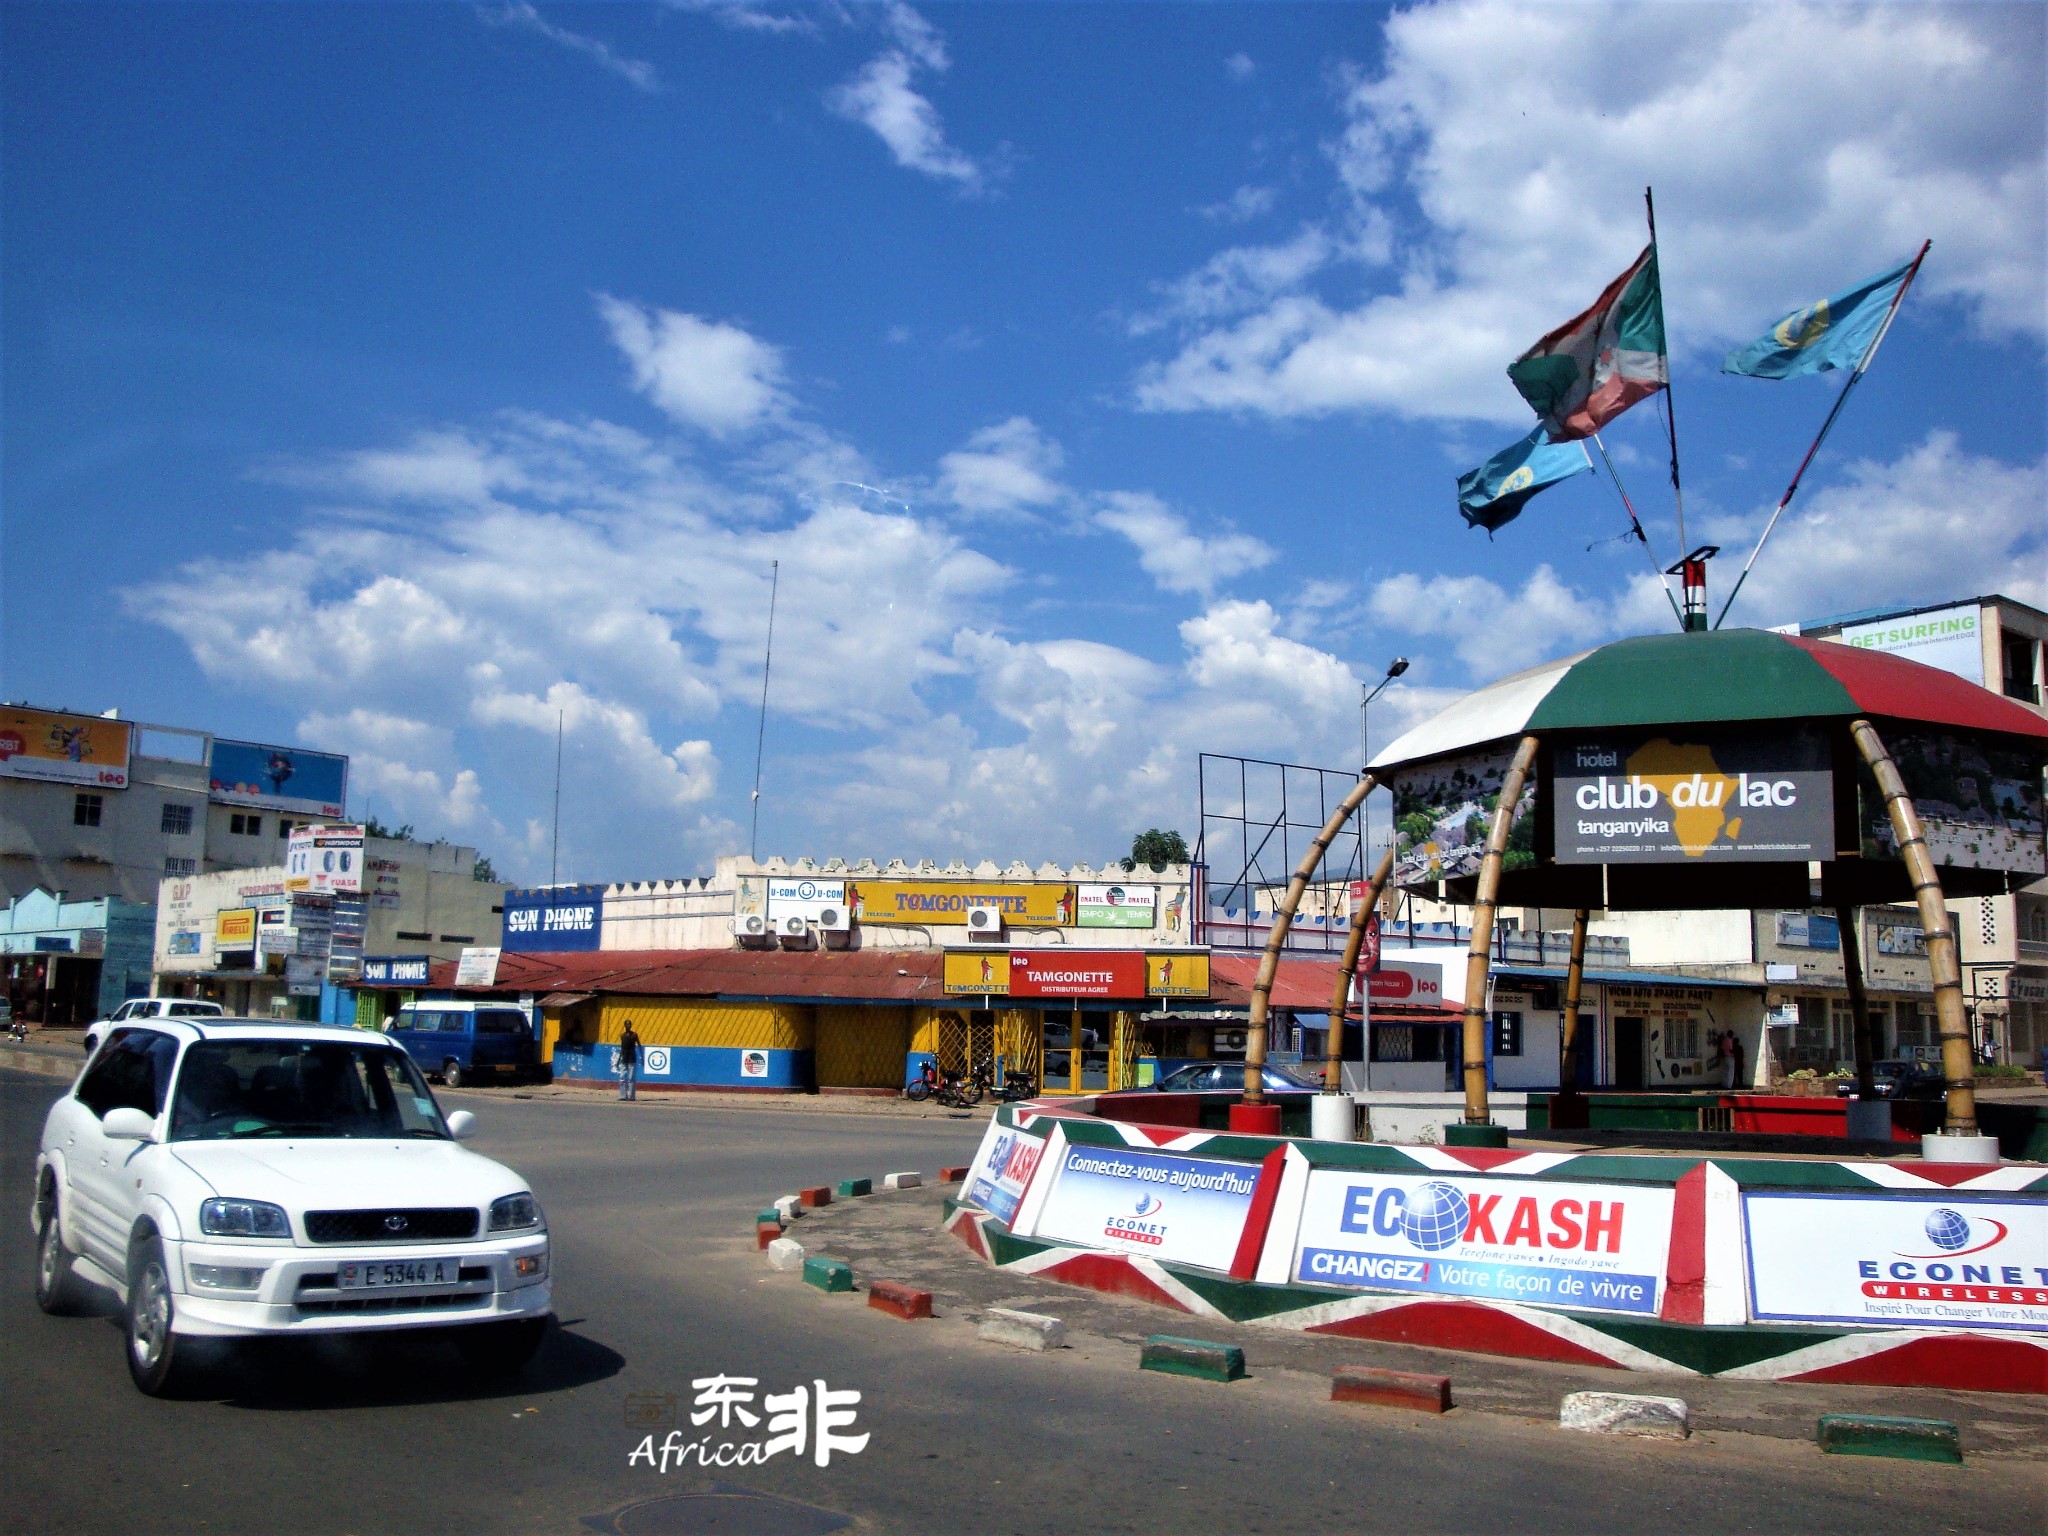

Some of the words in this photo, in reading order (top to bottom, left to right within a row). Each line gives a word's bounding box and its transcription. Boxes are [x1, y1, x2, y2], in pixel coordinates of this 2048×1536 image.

[1850, 631, 1886, 648] GET
[1888, 616, 1976, 641] SURFING
[1576, 751, 1617, 768] hotel
[1576, 775, 1658, 810] club
[1672, 773, 1725, 807] du
[1739, 773, 1797, 807] lac
[1577, 818, 1669, 837] tanganyika
[1576, 846, 1594, 854] phone
[771, 888, 796, 898] U-COM
[817, 889, 843, 899] U-COM
[508, 907, 539, 932] SUN
[543, 906, 595, 931] PHONE
[1078, 910, 1104, 918] TEMPO
[1126, 911, 1152, 919] TEMPO
[1012, 957, 1028, 966] leo
[391, 962, 427, 980] PHONE
[1026, 971, 1113, 984] TAMGONETTE
[1634, 986, 1652, 998] AUTO
[1068, 1152, 1169, 1185] Connectez-vous
[1169, 1166, 1254, 1196] aujourd'hui
[1106, 1216, 1168, 1236] ECONET
[1459, 1246, 1505, 1262] Terefone
[1506, 1252, 1535, 1264] yawe
[1548, 1254, 1589, 1267] Ingodo
[1590, 1258, 1620, 1269] yawe
[366, 1266, 376, 1284] E
[384, 1263, 427, 1284] 5344
[434, 1262, 443, 1282] A
[1310, 1252, 1430, 1283] CHANGEZ!
[1437, 1263, 1490, 1288] Votre
[1493, 1269, 1550, 1296] façon
[1558, 1271, 1583, 1294] de
[1590, 1276, 1643, 1300] vivre
[1858, 1260, 2048, 1285] ECONET
[1872, 1285, 2048, 1303] WIRELESS
[1865, 1301, 1902, 1315] Inspiré
[1905, 1303, 1931, 1316] Pour
[1934, 1304, 1982, 1318] Changer
[1985, 1307, 2017, 1319] Votre
